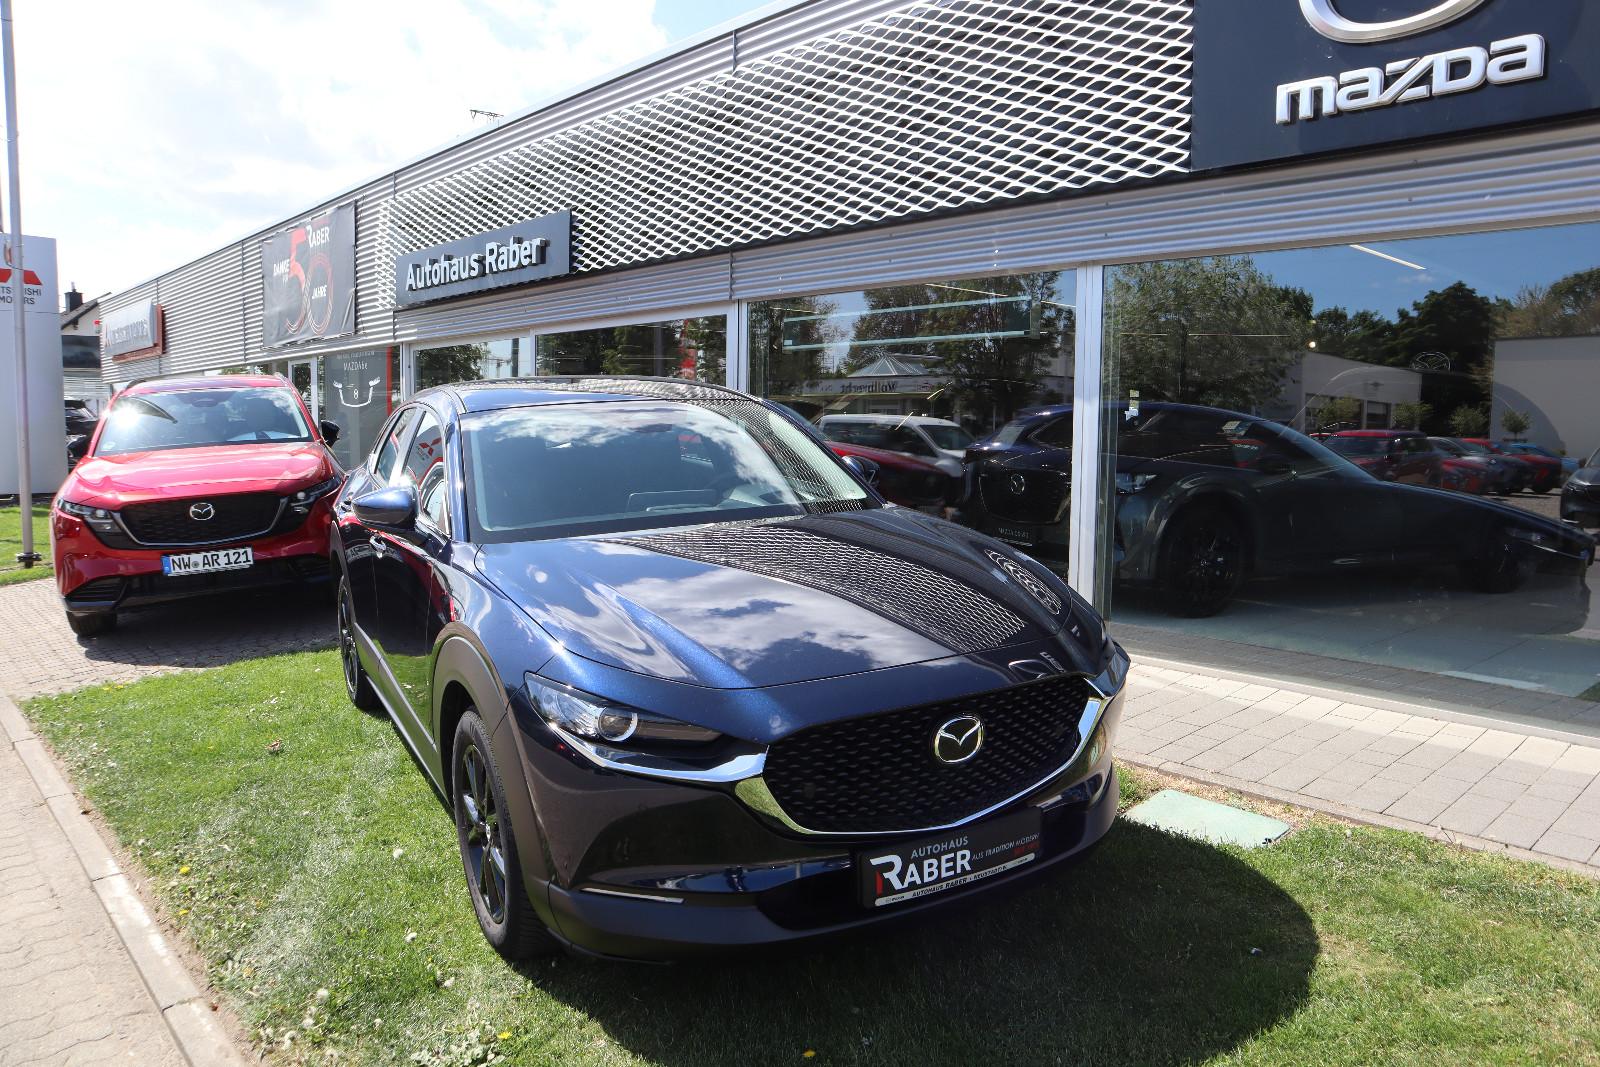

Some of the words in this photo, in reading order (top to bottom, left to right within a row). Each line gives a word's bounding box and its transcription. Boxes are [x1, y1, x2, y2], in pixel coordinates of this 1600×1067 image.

[306, 225, 330, 248] RABER
[405, 253, 481, 291] Autohaus
[485, 235, 547, 274] Raber
[0, 295, 35, 305] MORS
[171, 556, 191, 571] NW
[202, 554, 221, 568] AR
[223, 550, 252, 566] 121
[910, 835, 969, 859] AUTOHAUS
[869, 850, 972, 894] RABER
[944, 877, 967, 890] RABER
